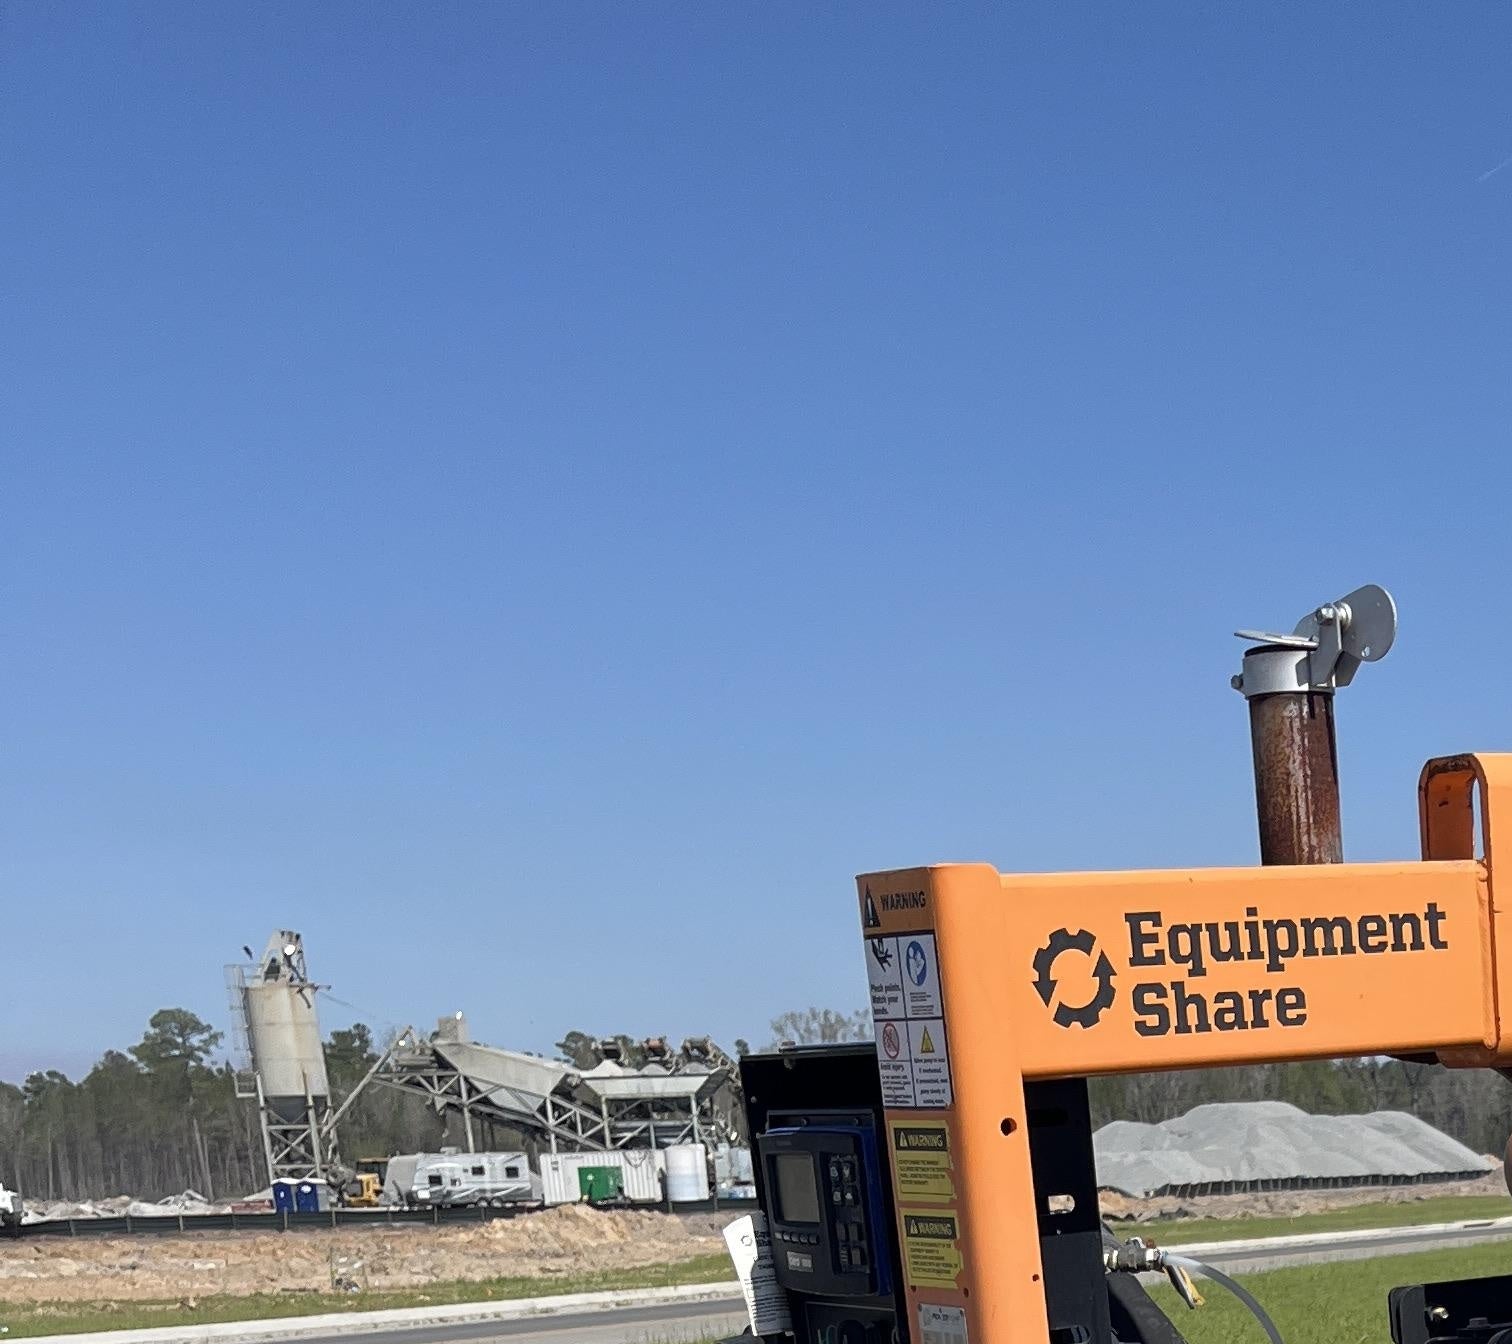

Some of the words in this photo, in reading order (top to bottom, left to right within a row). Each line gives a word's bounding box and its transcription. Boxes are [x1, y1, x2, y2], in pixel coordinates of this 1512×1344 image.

[880, 890, 926, 911] WARNING
[1124, 902, 1449, 978] Equipment
[1131, 980, 1308, 1037] Share
[907, 1133, 944, 1148] WARNING
[917, 1221, 953, 1236] WARNING
